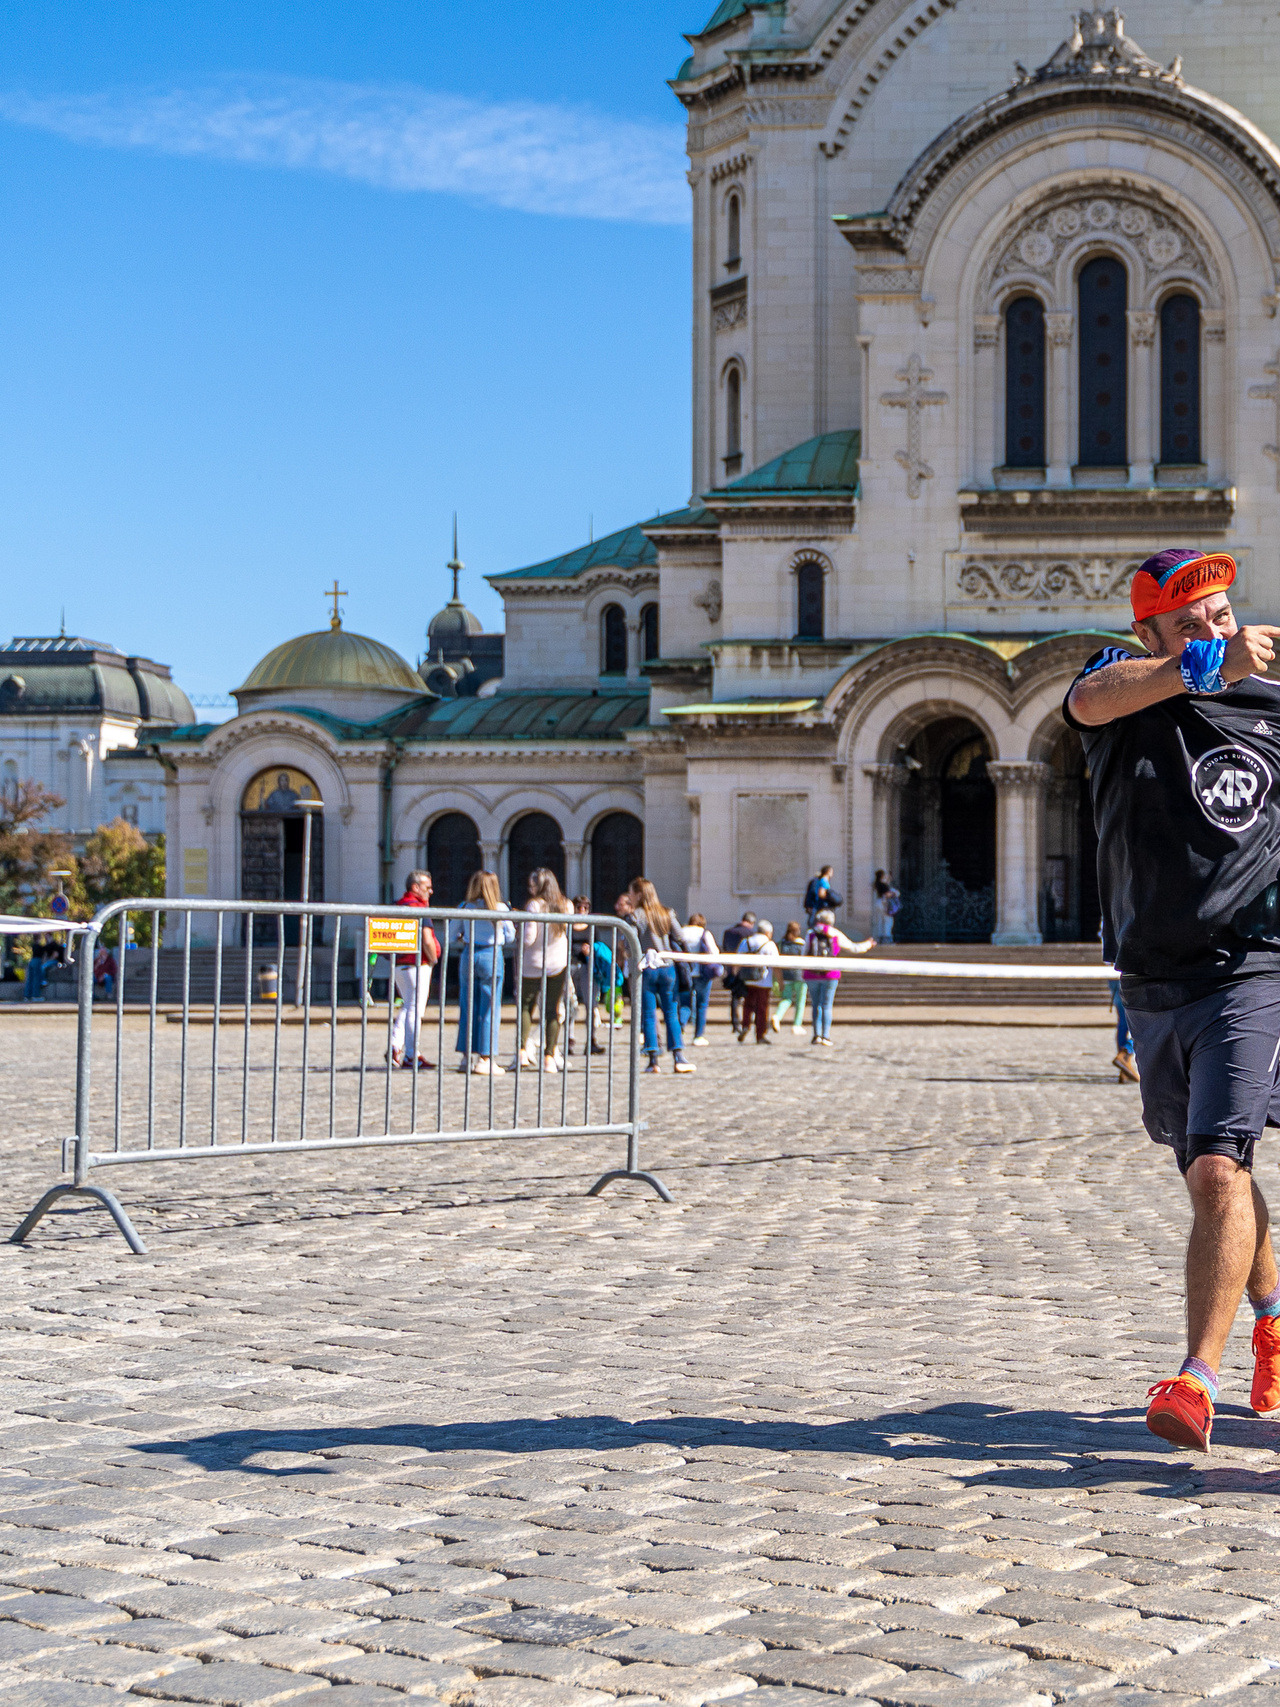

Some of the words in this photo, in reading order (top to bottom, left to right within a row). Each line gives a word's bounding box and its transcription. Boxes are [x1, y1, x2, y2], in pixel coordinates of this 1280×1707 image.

[1252, 728, 1273, 736] adidas
[1203, 754, 1228, 772] ADIDAS
[1232, 753, 1261, 773] RUNNERS
[1221, 816, 1241, 824] SOFIA
